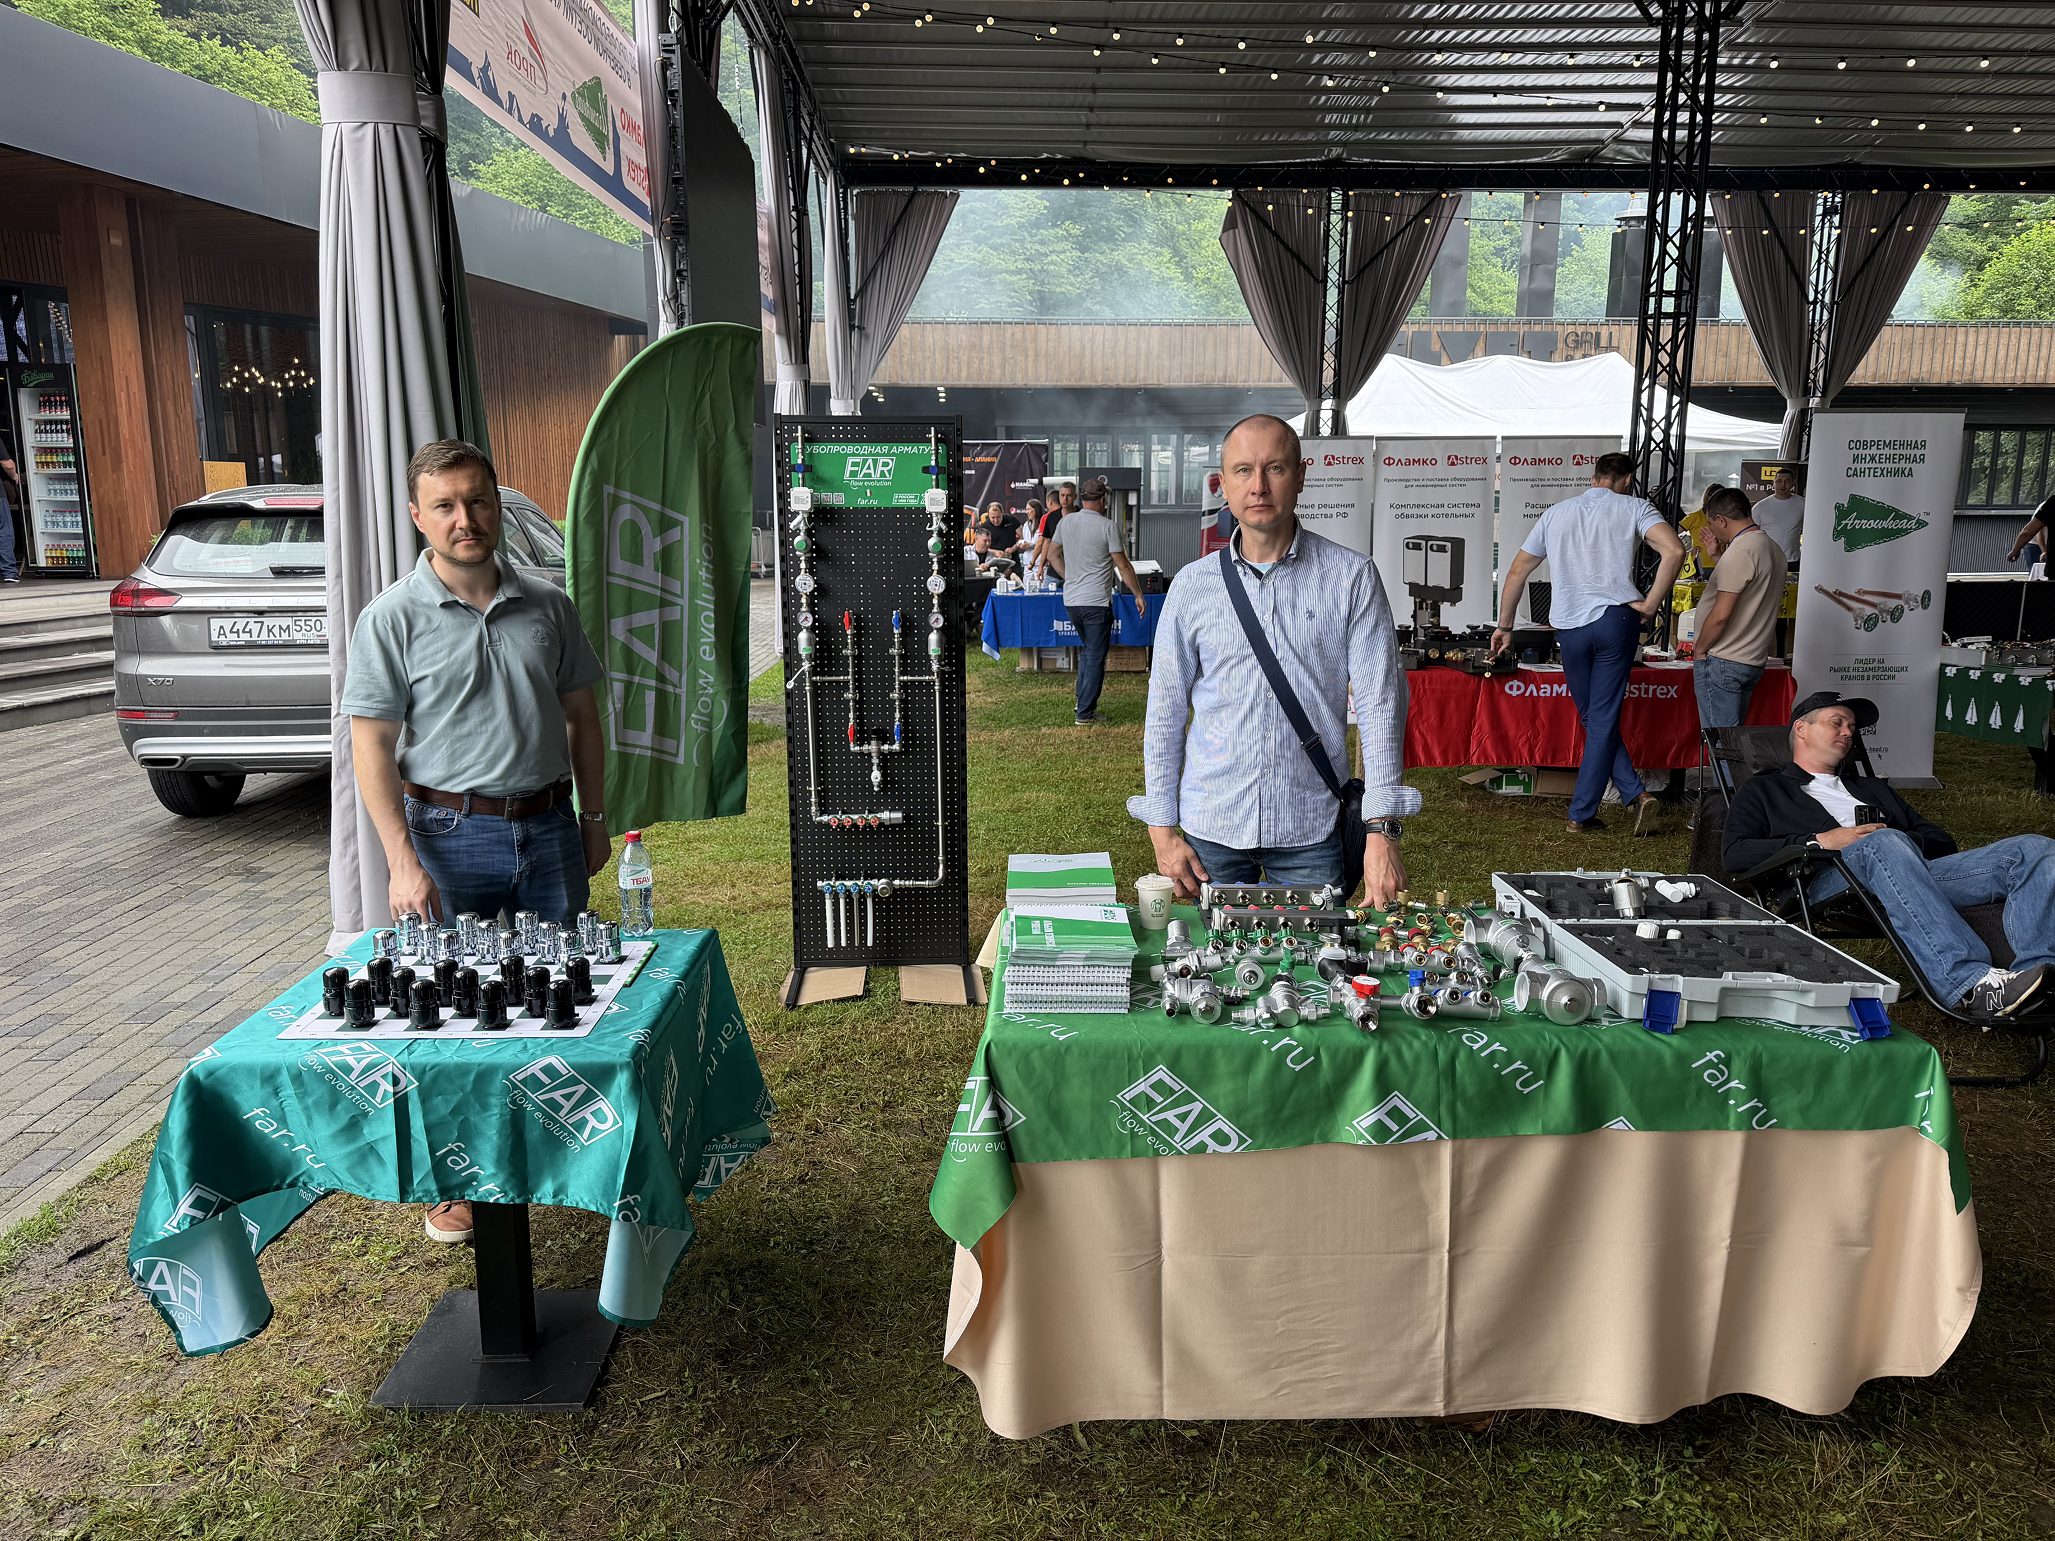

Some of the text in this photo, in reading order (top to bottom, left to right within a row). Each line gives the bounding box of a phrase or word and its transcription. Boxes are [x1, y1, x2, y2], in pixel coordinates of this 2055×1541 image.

[1565, 331, 1620, 350] GRILL
[796, 446, 943, 454] УБОПРОВОДНАЯ АРМАТУА
[1848, 439, 1927, 451] СОВРЕМЕННАЯ
[1324, 454, 1364, 466] Astrex
[1383, 456, 1438, 467] Фламко
[1447, 454, 1488, 466] Astrex
[1509, 455, 1563, 466] Фламко
[1572, 454, 1600, 466] Astr
[1852, 453, 1926, 464] ИНЖЕНЕРНАЯ
[845, 458, 895, 479] FAR
[1846, 466, 1914, 478] САНТЕХНИКА
[1389, 502, 1445, 510] Комплексная
[1394, 512, 1429, 520] обвязки
[1837, 512, 1921, 530] Arrowhead
[217, 618, 323, 639] А447КМ 550
[605, 496, 681, 758] FAR
[691, 522, 717, 735] flow evolution
[1852, 665, 1909, 674] НЕЗАМЕРЗАЮЩИХ
[1854, 658, 1877, 666] ЛИДЕР
[147, 677, 174, 687] X70
[1504, 680, 1572, 697] Флам
[1624, 682, 1679, 699] strex
[630, 875, 651, 886] ТБАУ
[264, 1005, 299, 1026] far.
[1222, 1022, 1315, 1072] r.ru
[1773, 1025, 1850, 1054] evolution
[705, 1013, 743, 1085] far.ru
[1447, 1027, 1545, 1095] far.ru
[316, 1042, 414, 1106] FAR
[324, 1072, 376, 1116] evolution
[1691, 1049, 1778, 1130] far.ru
[512, 1056, 618, 1143] FAR
[1121, 1068, 1245, 1155] FAR
[509, 1088, 581, 1154] flow evolution
[1118, 1109, 1149, 1137] flow
[243, 1107, 327, 1169] far.ru
[949, 1138, 981, 1156] flow
[704, 1143, 738, 1153] evoluti
